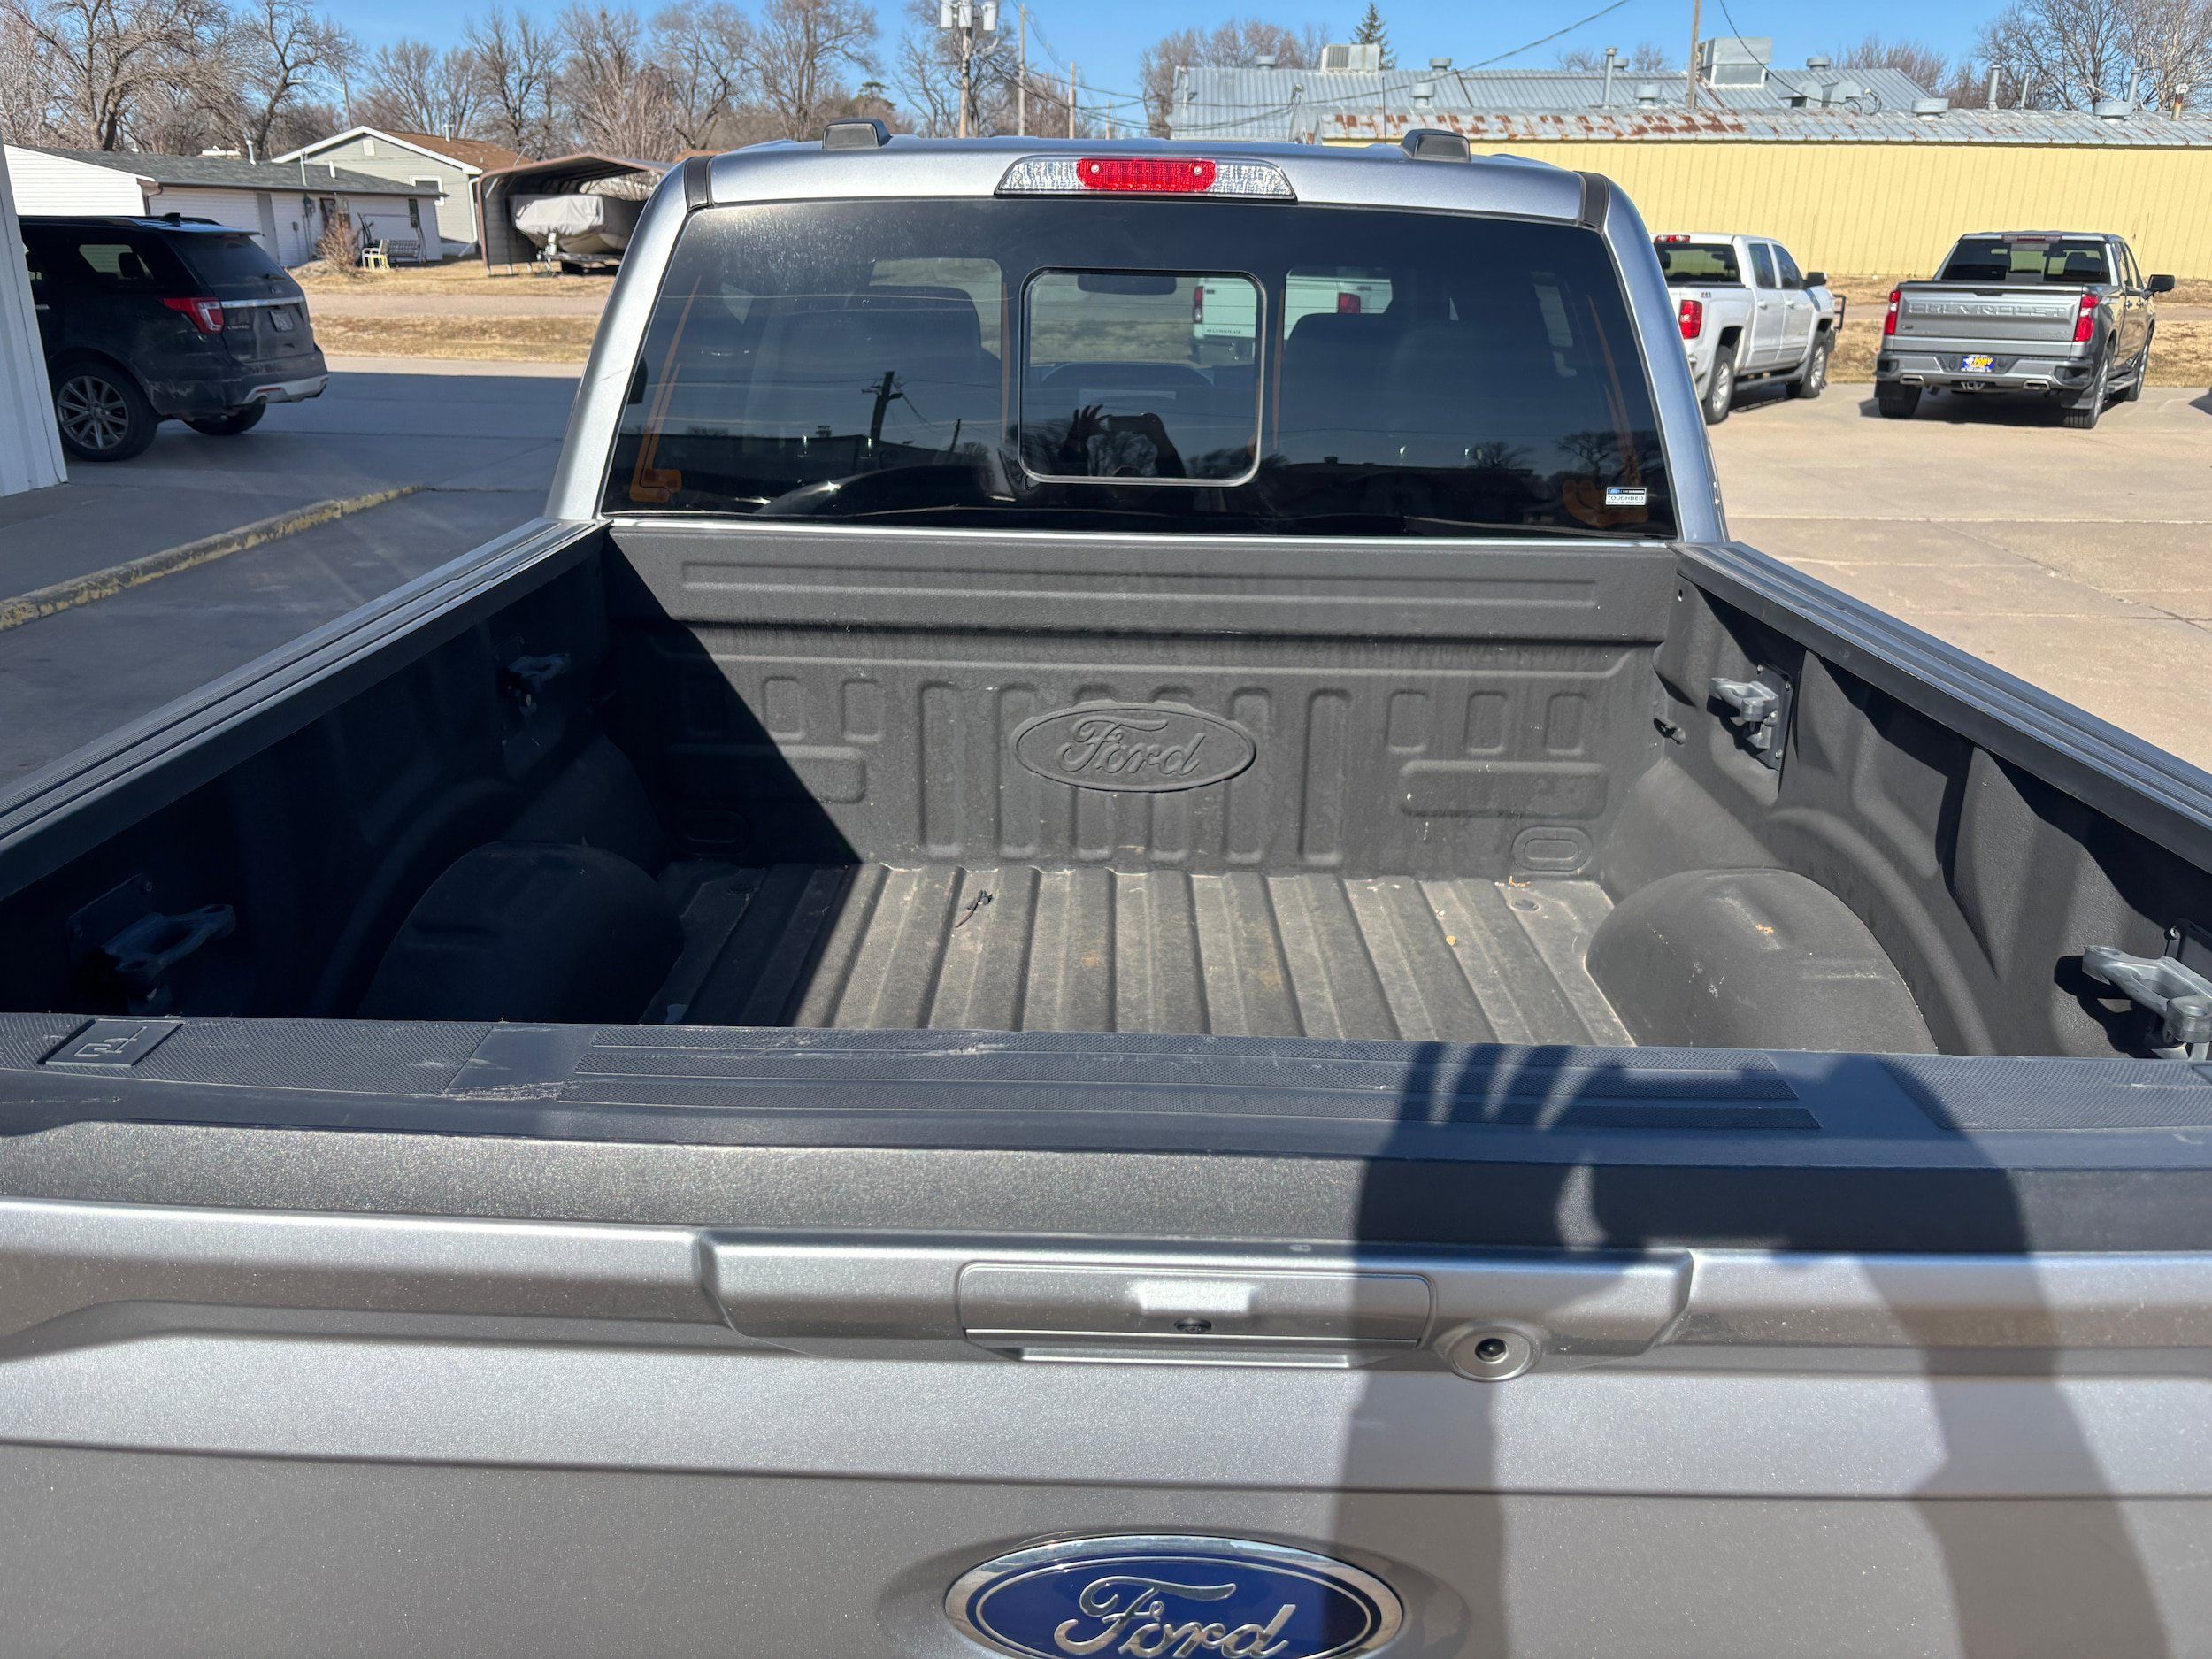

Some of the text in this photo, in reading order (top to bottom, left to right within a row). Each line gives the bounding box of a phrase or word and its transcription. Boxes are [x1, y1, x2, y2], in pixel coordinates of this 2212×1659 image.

[1909, 303, 2068, 318] CHEVROLET
[1057, 715, 1206, 776] Ford
[1054, 1575, 1296, 1659] Ford
